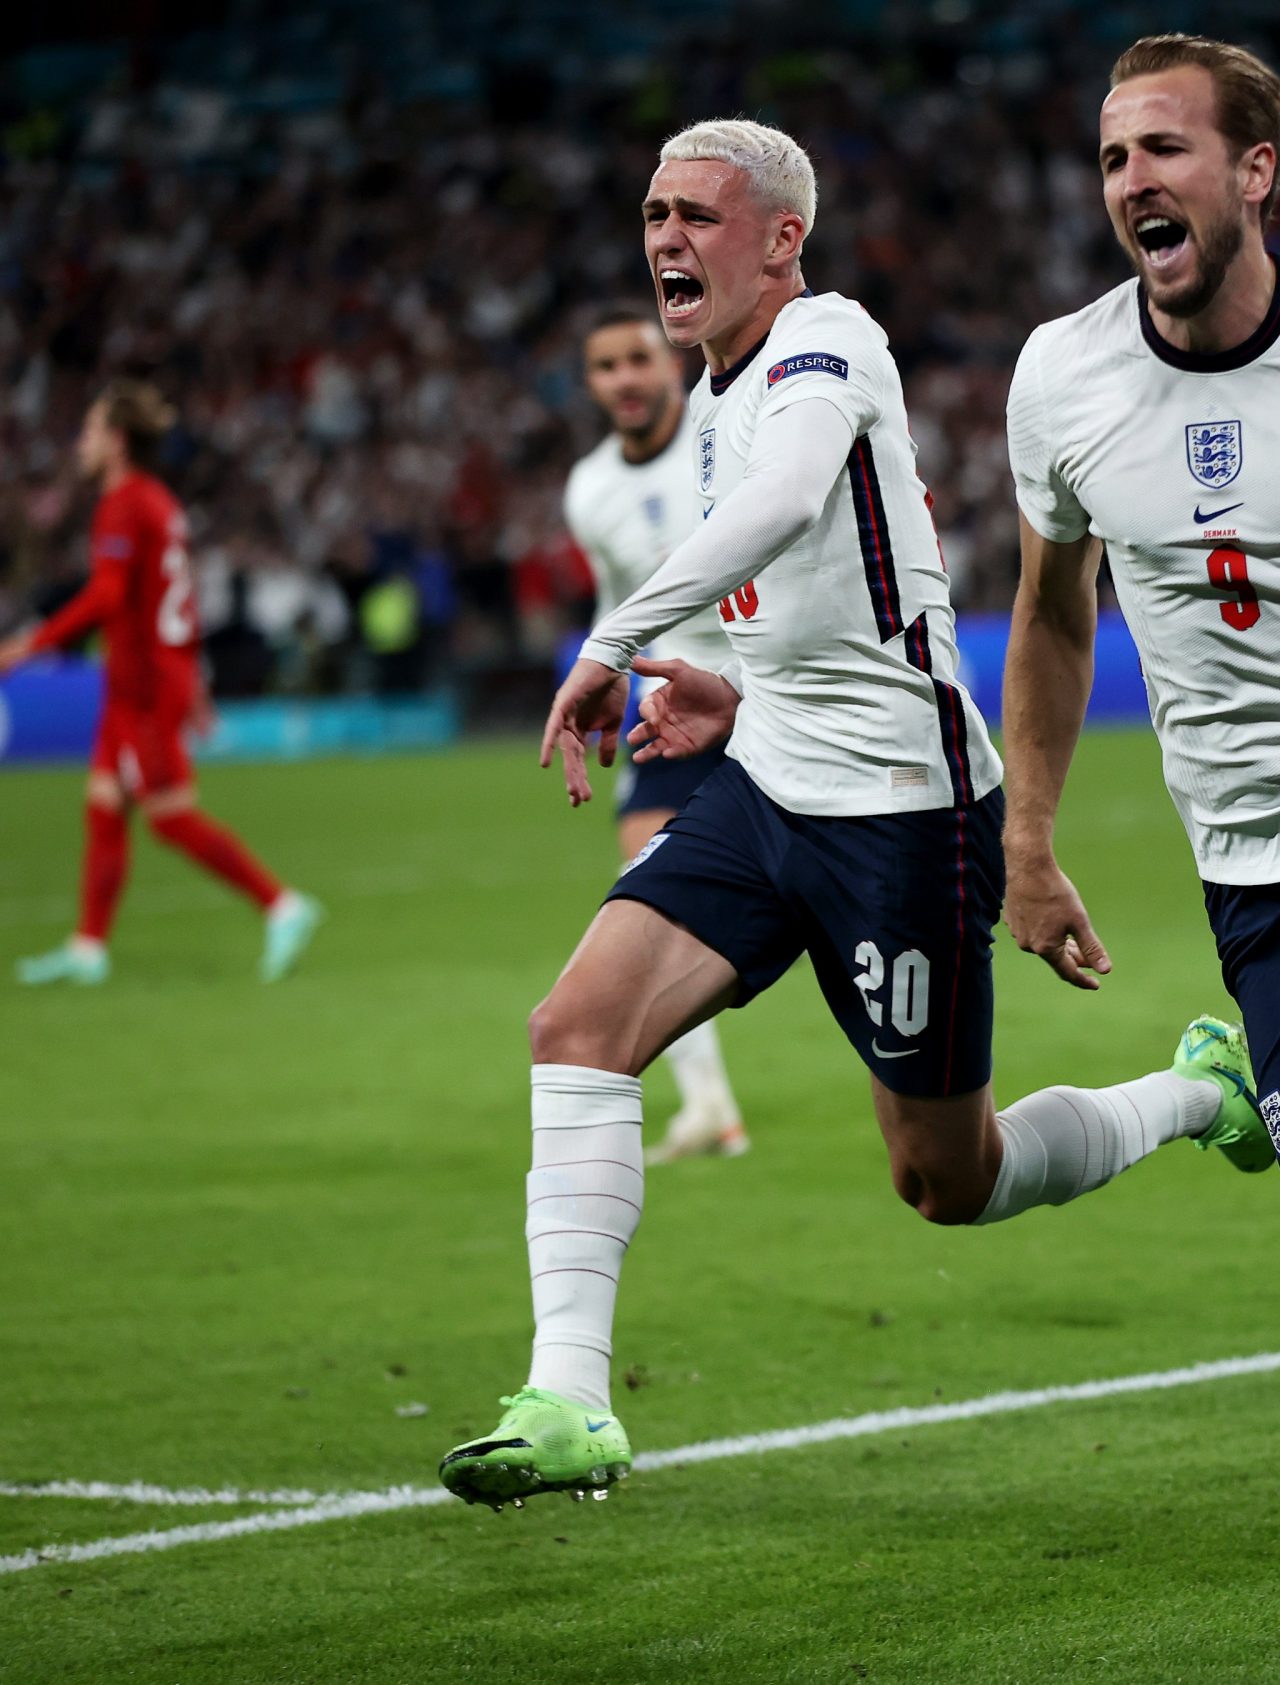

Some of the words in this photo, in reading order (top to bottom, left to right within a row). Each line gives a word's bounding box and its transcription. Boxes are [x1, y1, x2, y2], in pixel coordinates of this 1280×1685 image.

[787, 357, 848, 374] RESPECT
[1203, 528, 1237, 538] DENMARK
[1206, 543, 1261, 632] 9
[852, 940, 930, 1037] 20
